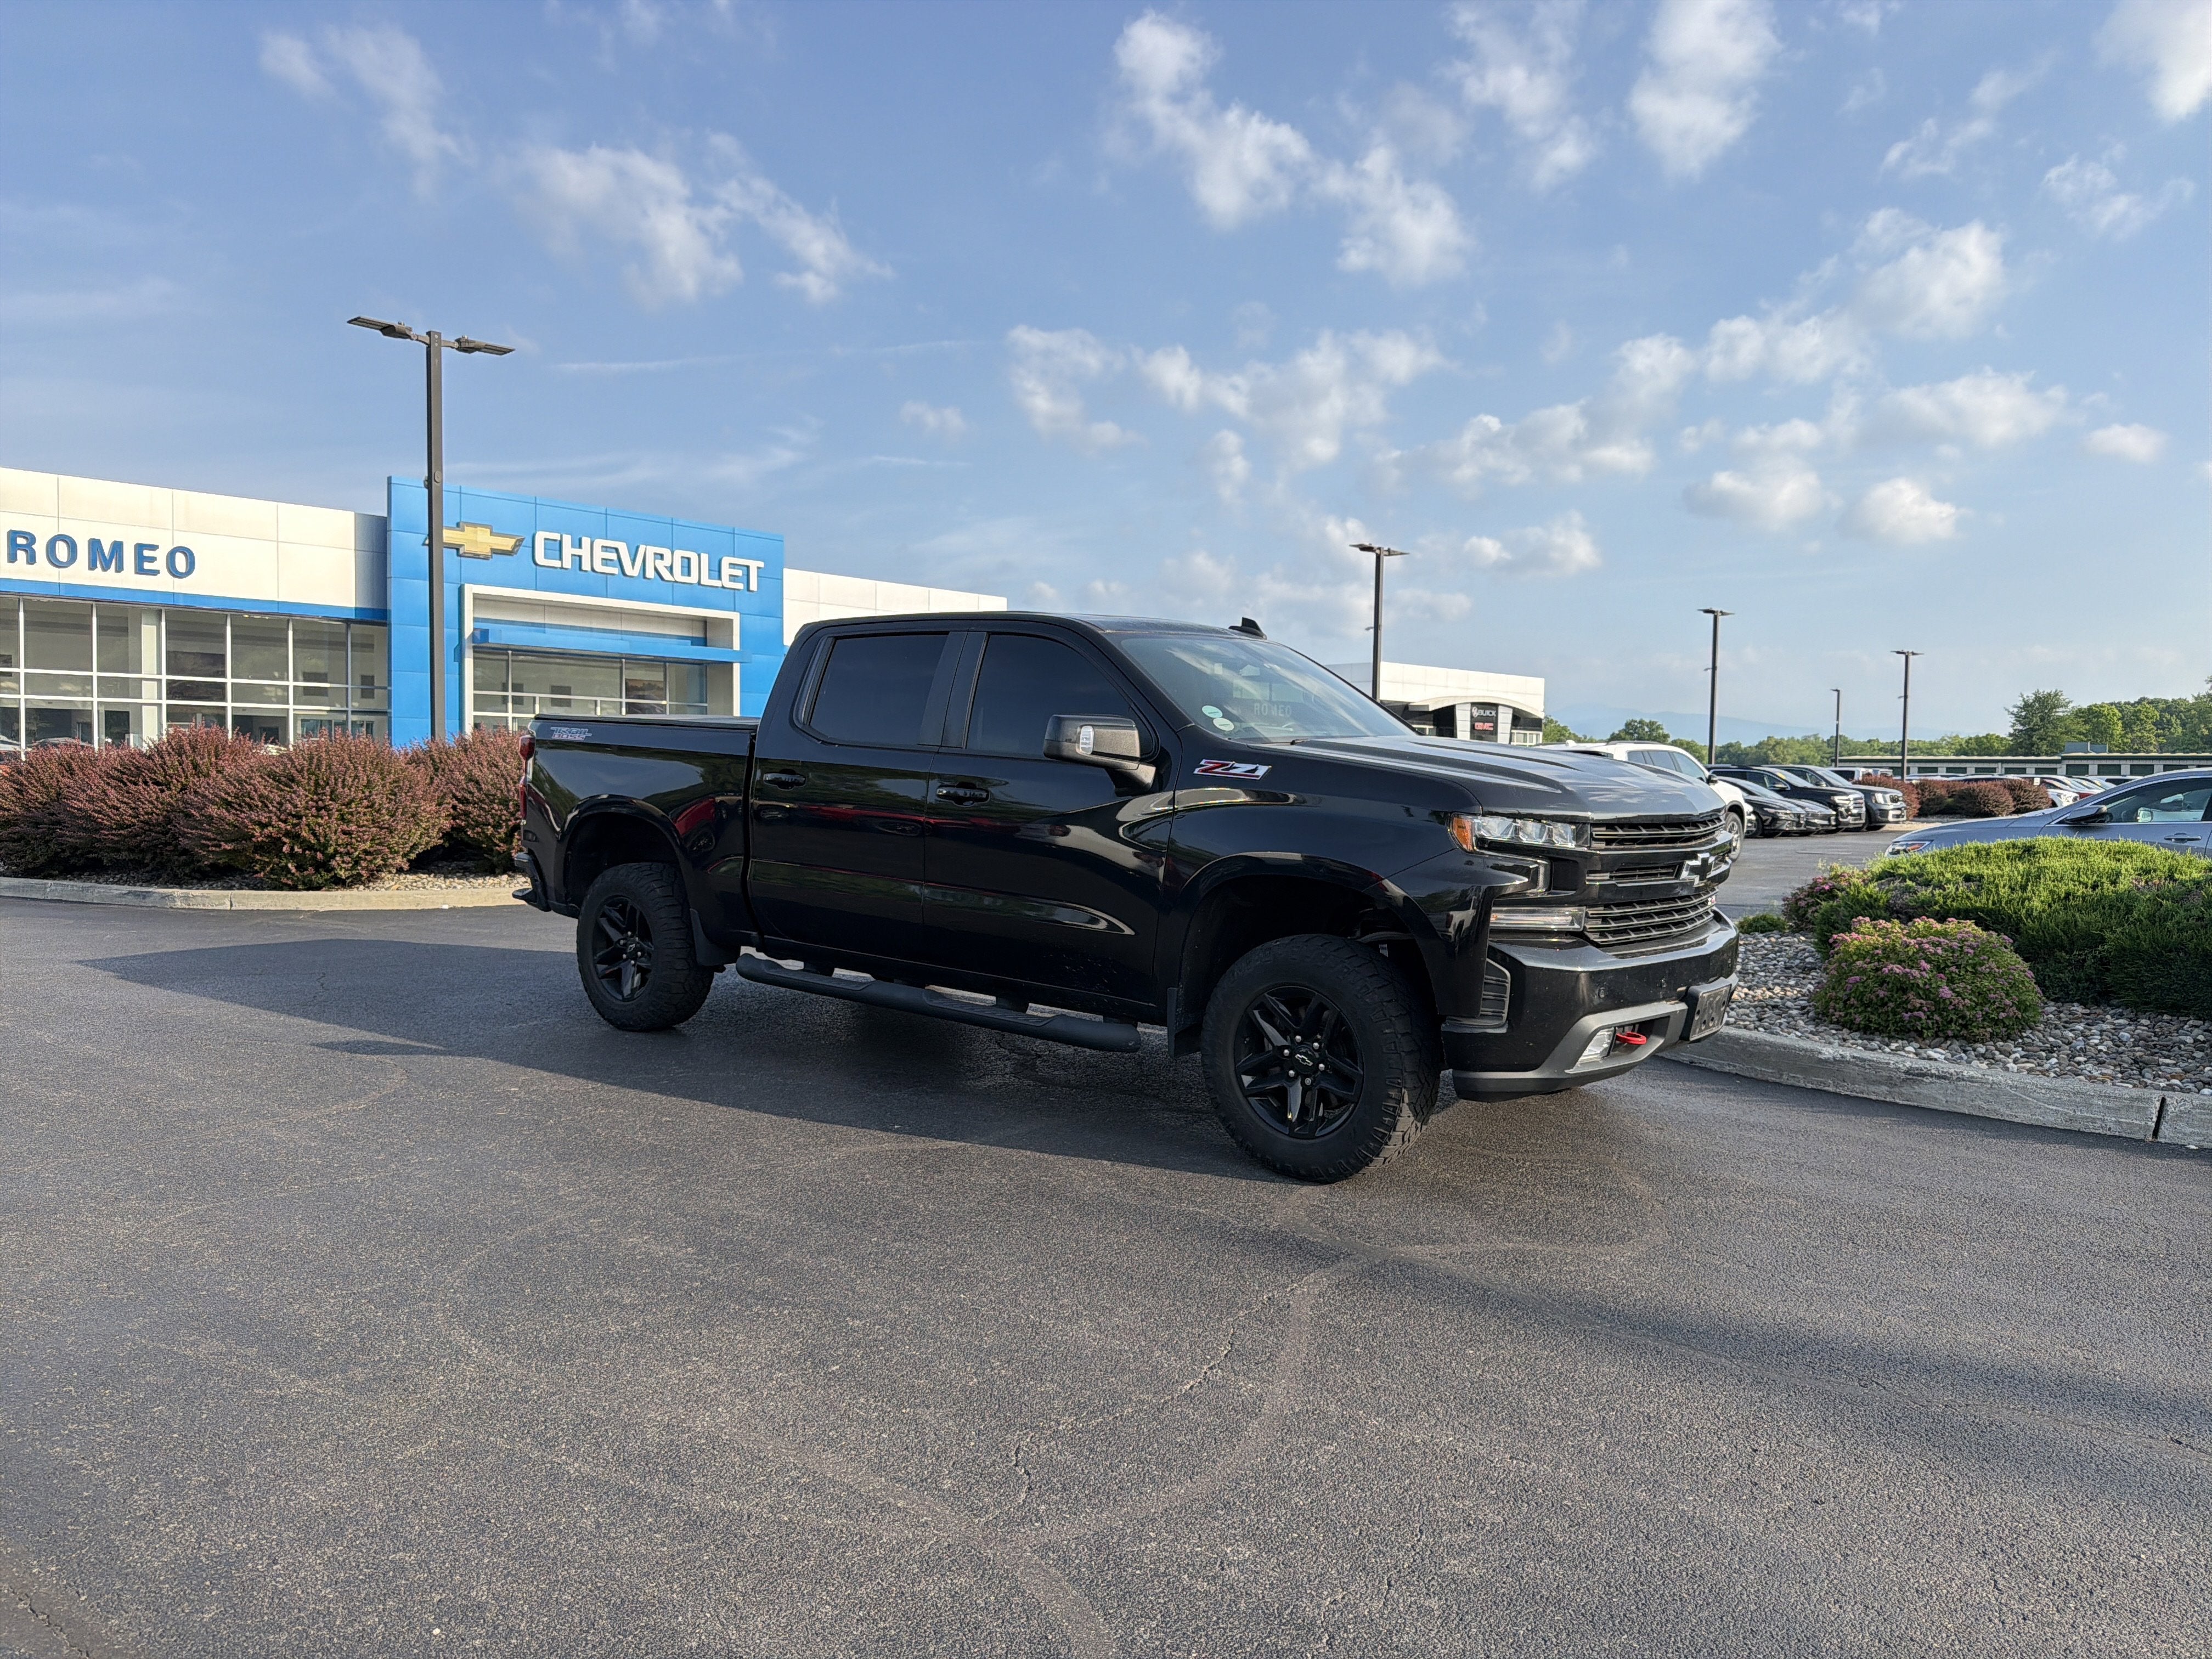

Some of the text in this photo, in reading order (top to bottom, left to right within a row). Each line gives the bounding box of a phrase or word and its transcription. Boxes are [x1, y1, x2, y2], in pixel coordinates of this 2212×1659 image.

[7, 529, 195, 579] ROMEO
[534, 531, 764, 592] CHEVROLET
[550, 727, 592, 736] TRAIL
[1474, 722, 1494, 731] GMC
[1193, 759, 1272, 780] Z71
